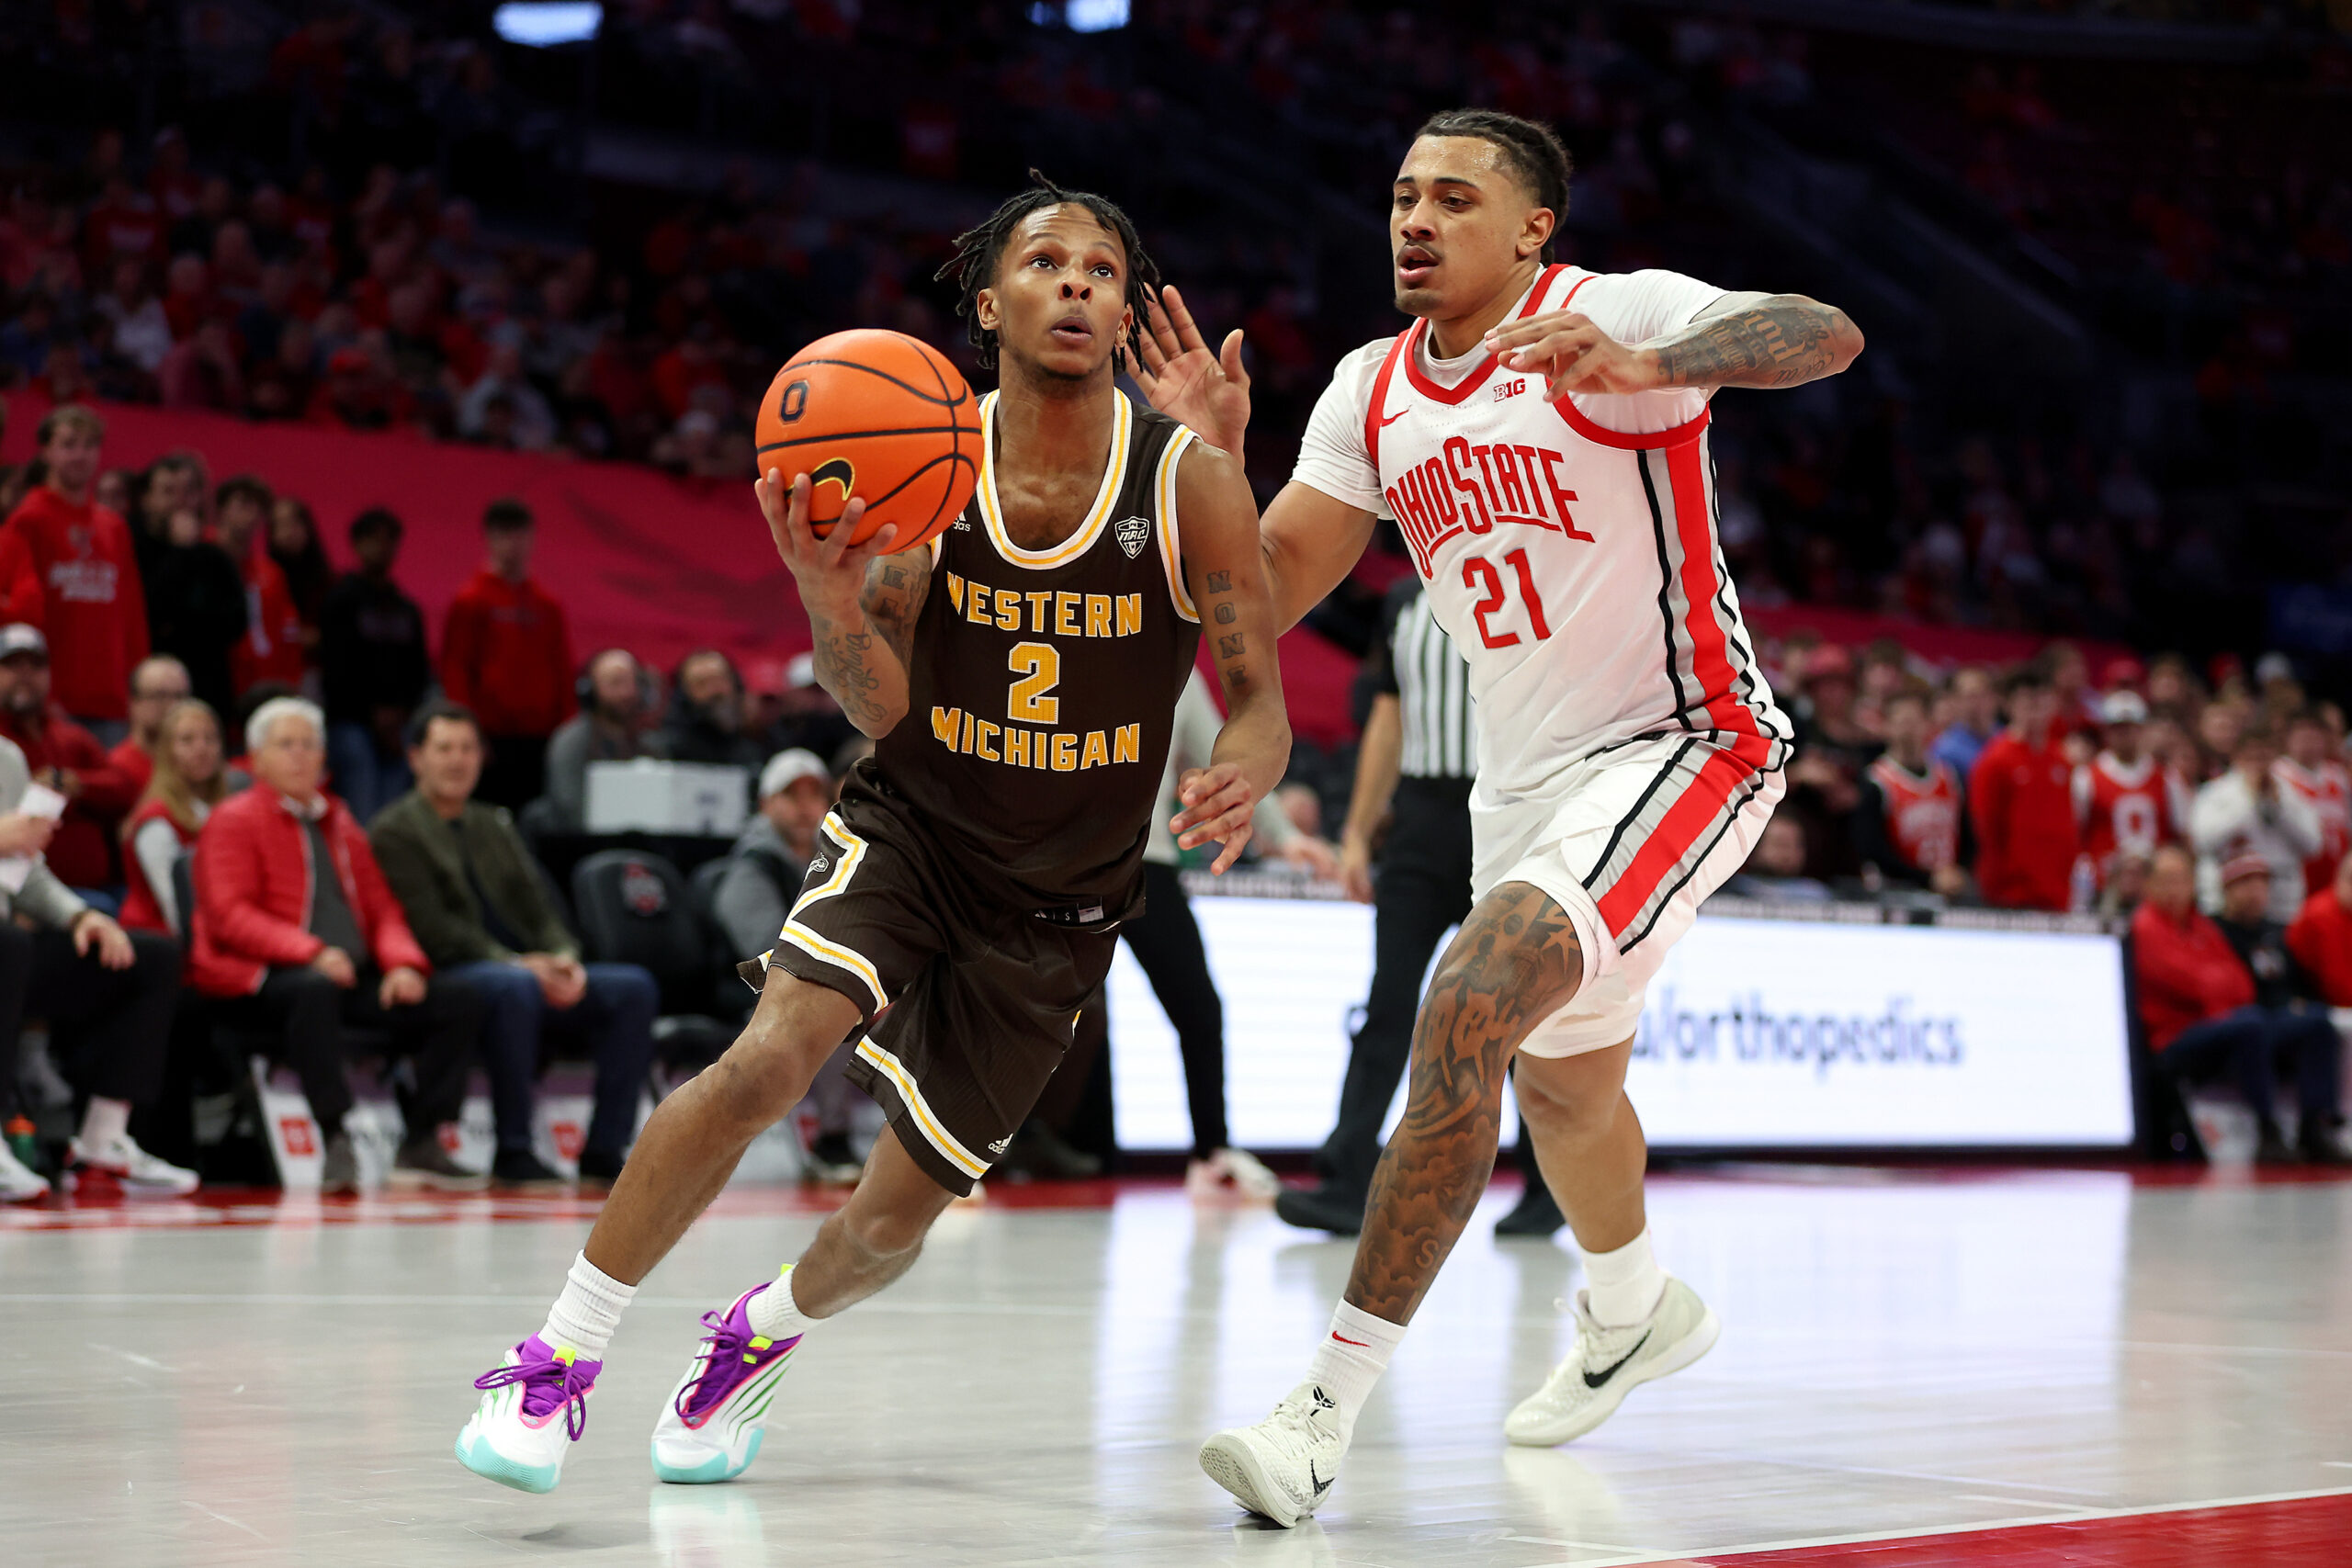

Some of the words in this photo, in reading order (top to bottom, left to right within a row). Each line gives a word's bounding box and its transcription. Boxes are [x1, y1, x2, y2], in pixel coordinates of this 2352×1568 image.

[1443, 435, 1596, 544] STATE
[1462, 547, 1553, 649] 21
[1007, 641, 1060, 725] 2
[931, 705, 1140, 772] MICHIGAN
